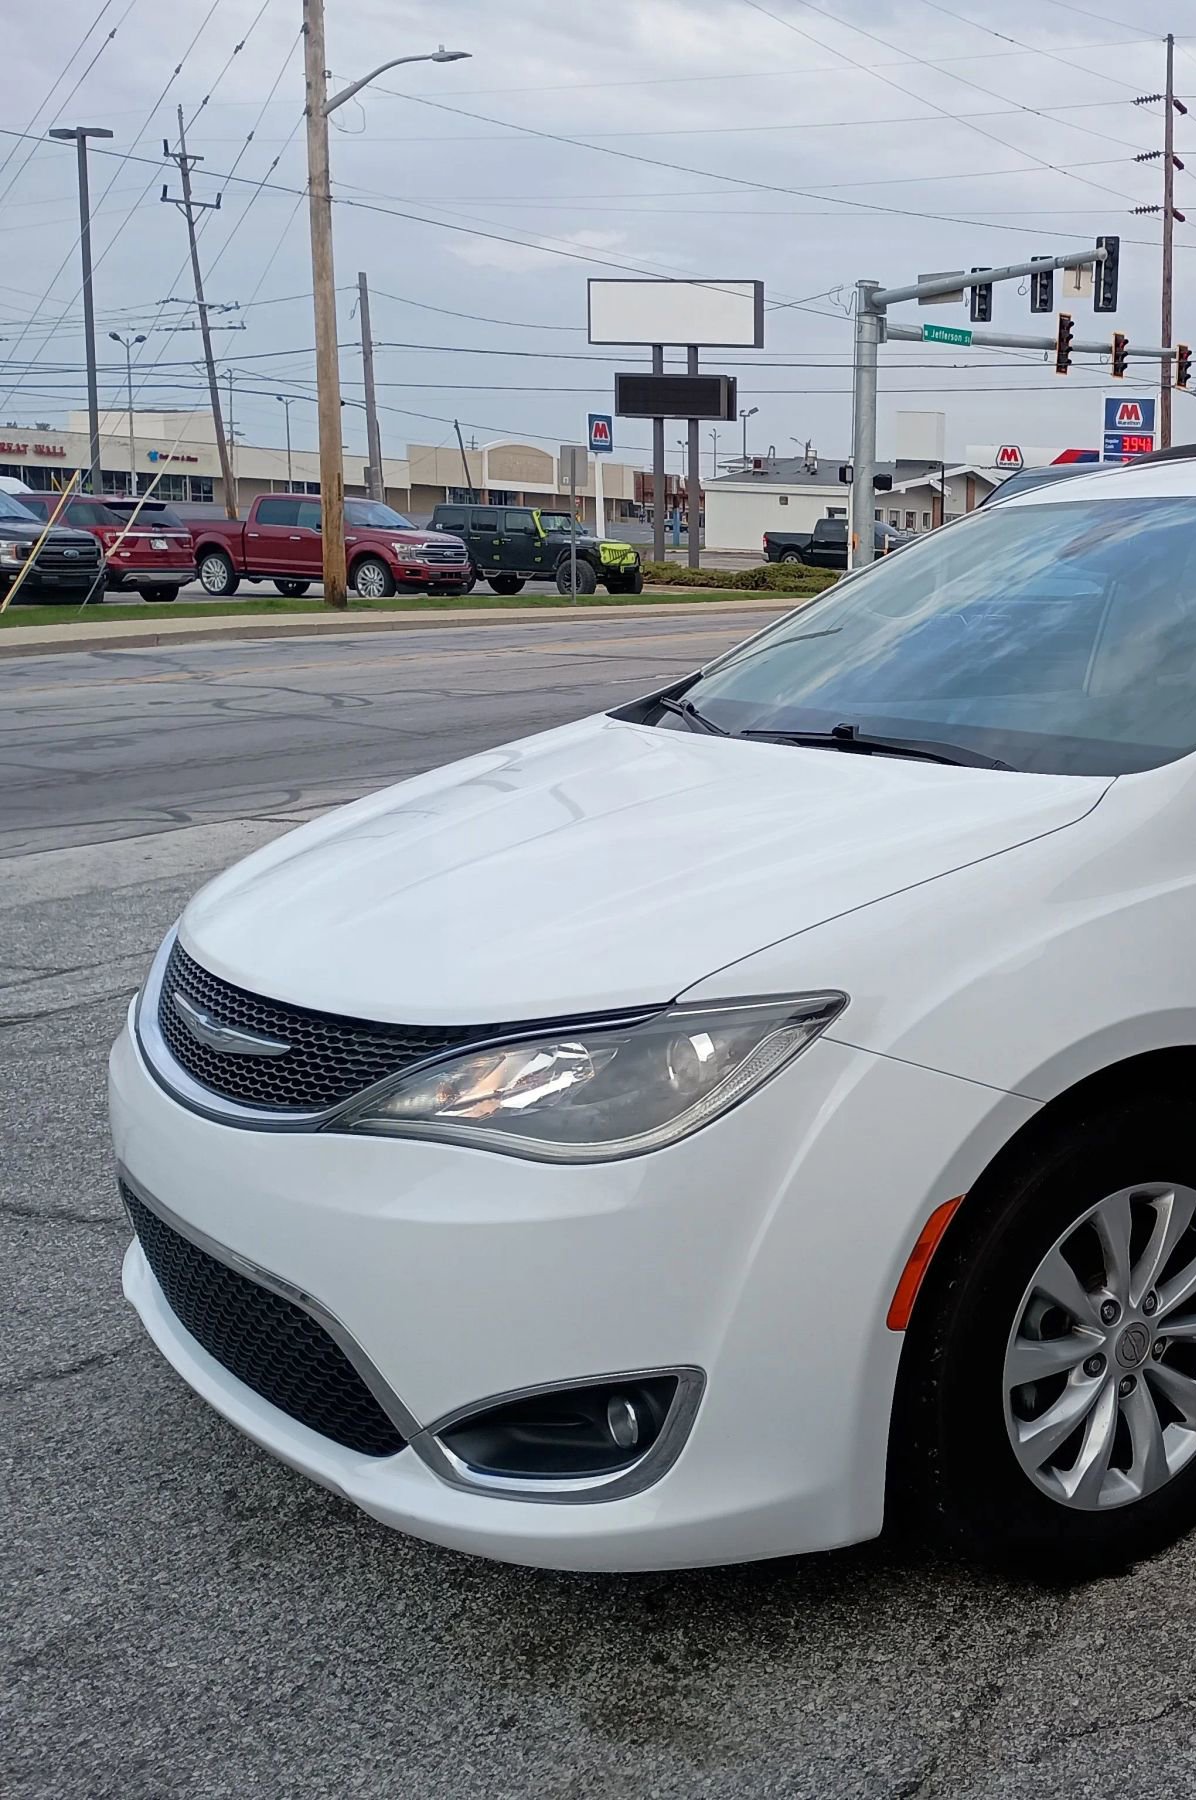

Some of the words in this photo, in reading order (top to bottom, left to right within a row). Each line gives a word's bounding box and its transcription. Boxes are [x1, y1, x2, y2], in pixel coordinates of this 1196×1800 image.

[931, 329, 962, 342] Jefferson
[1119, 404, 1140, 420] M
[593, 422, 609, 439] M
[33, 443, 67, 457] WALL
[1000, 448, 1018, 462] M
